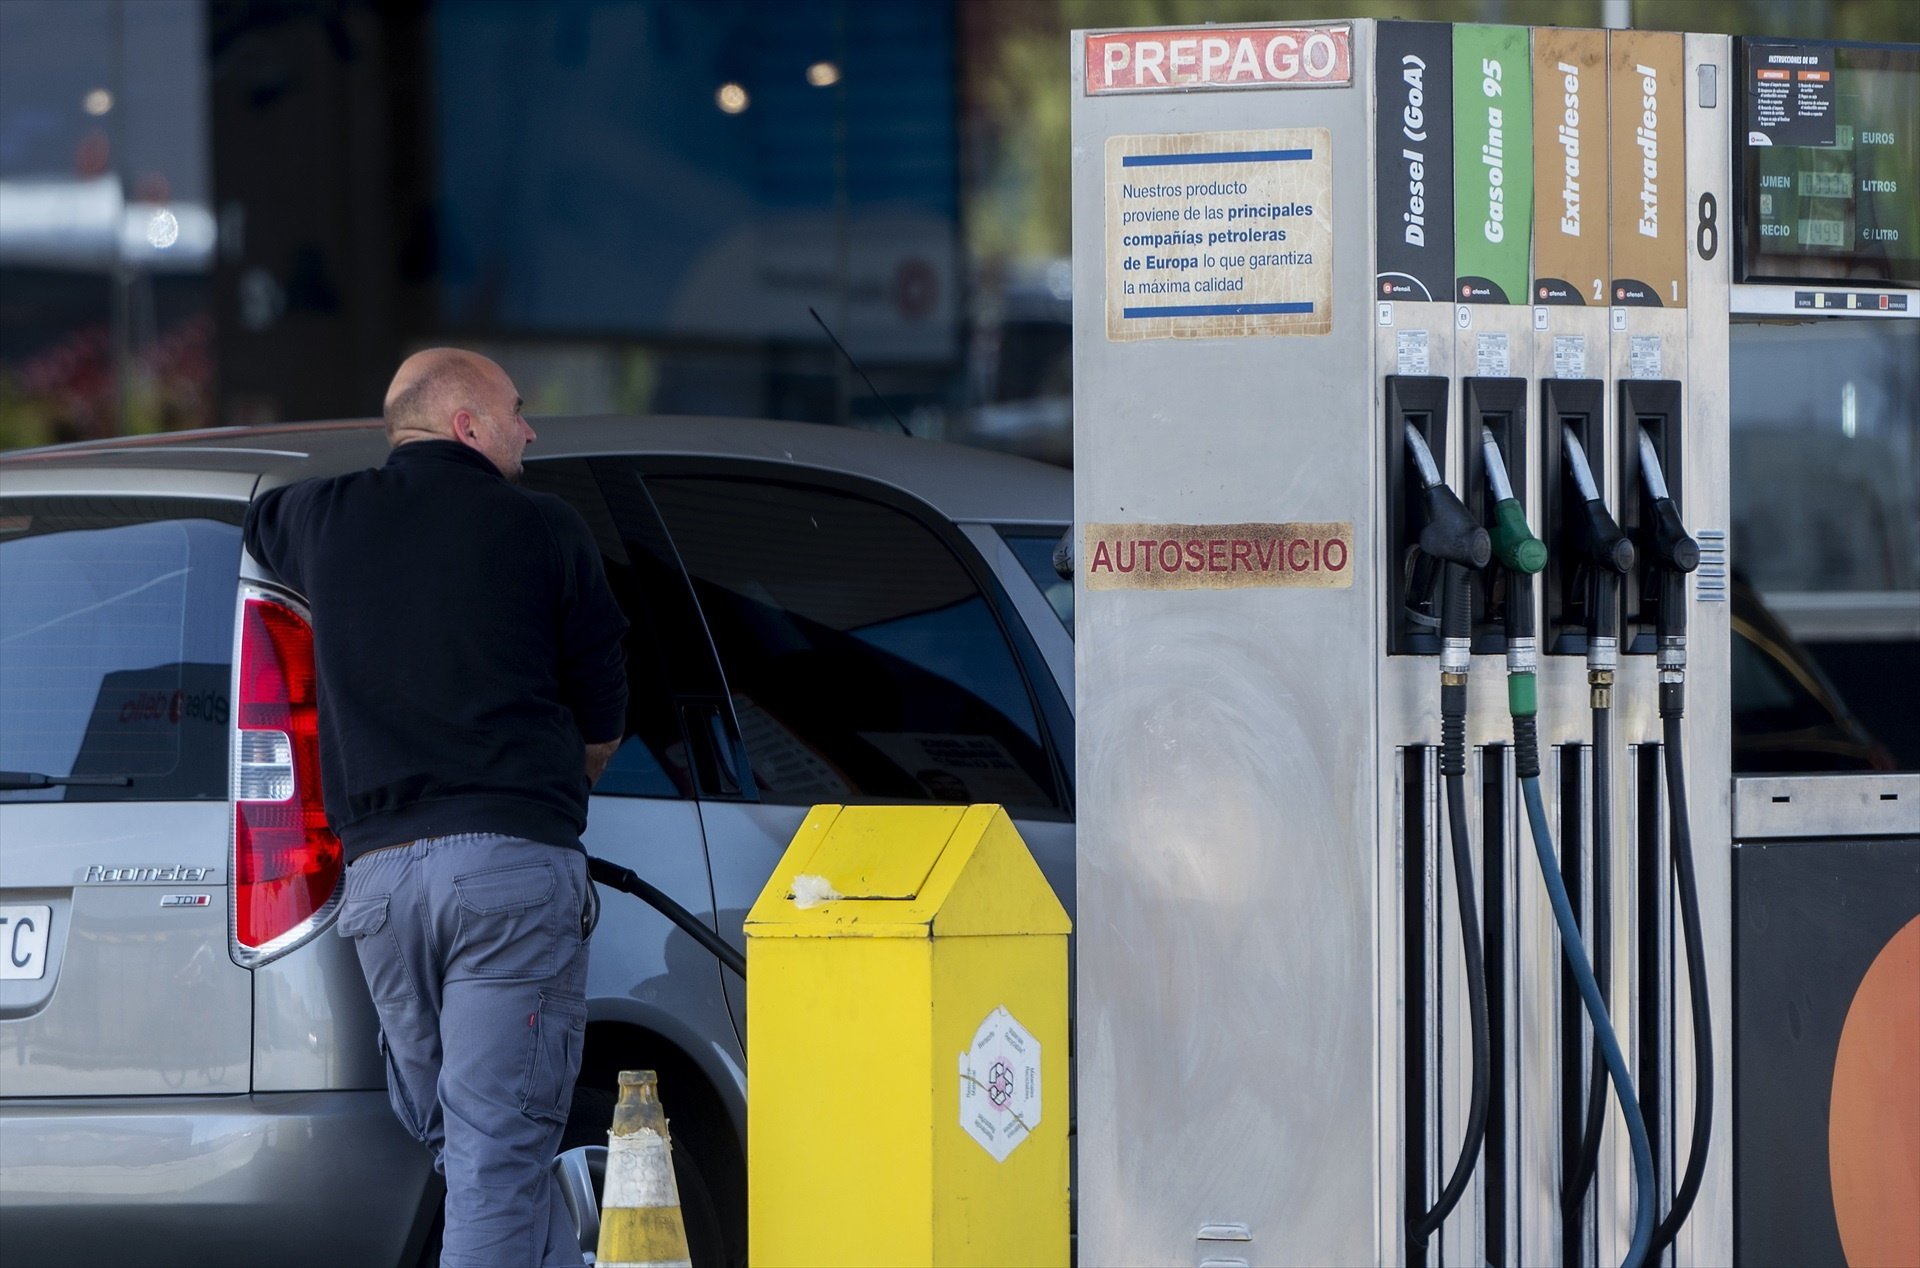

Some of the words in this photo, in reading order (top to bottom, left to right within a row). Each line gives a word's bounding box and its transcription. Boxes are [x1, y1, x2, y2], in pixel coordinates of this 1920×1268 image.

[1104, 33, 1337, 86] PREPAGO
[1482, 58, 1502, 96] 95
[1402, 55, 1427, 141] (GoA)
[1862, 132, 1894, 144] EUROS
[1558, 62, 1580, 237] Extradiesel
[1636, 64, 1658, 238] Extradiesel
[1482, 107, 1503, 243] Gasolina
[1760, 176, 1790, 188] UMEN
[1123, 184, 1182, 199] Nuestros
[1187, 181, 1247, 200] producto
[1862, 180, 1897, 192] LITROS
[1403, 149, 1424, 247] Diesel
[1123, 207, 1180, 226] proviene
[1184, 205, 1200, 221] de
[1205, 205, 1224, 220] las
[1228, 202, 1313, 221] principales
[1697, 192, 1718, 261] 8
[1760, 224, 1790, 236] RECIO
[1876, 229, 1899, 240] LITRO
[1123, 230, 1203, 248] compañías
[1208, 228, 1286, 246] petroleras
[1123, 256, 1141, 271] de
[1146, 255, 1199, 272] Europa
[1203, 253, 1216, 268] lo
[1220, 255, 1245, 270] que
[1249, 250, 1313, 270] garantiza
[1123, 280, 1135, 295] la
[1139, 278, 1191, 294] máxima
[1194, 276, 1243, 293] calidad
[1593, 279, 1602, 300] 2
[1672, 280, 1678, 301] 1
[1091, 538, 1348, 573] AUTOSERVICIO
[84, 864, 215, 883] Roomster
[176, 895, 197, 905] TDI
